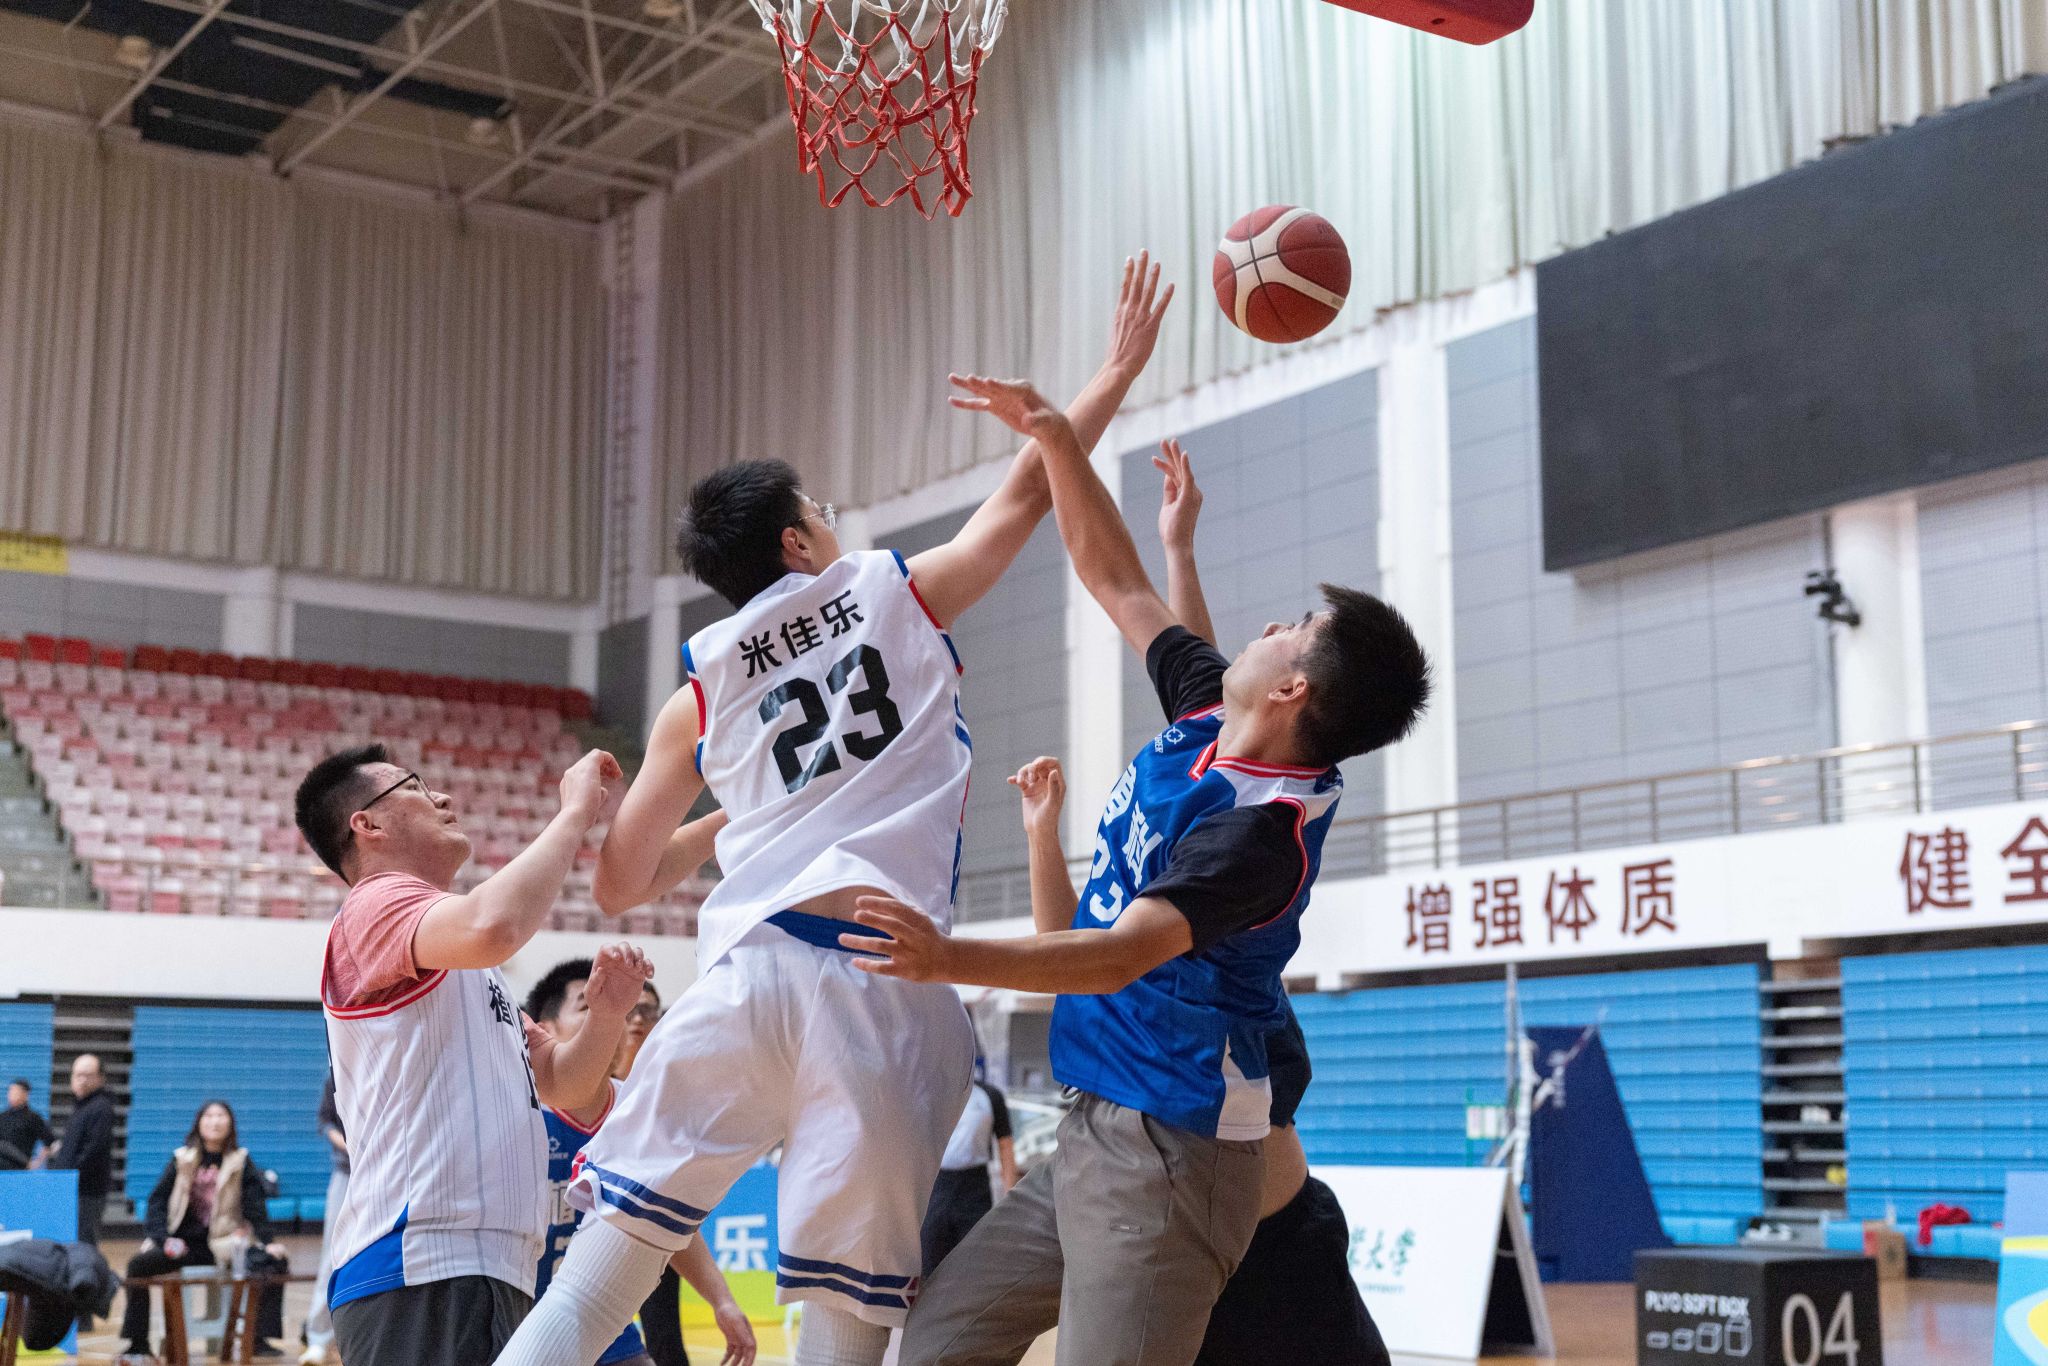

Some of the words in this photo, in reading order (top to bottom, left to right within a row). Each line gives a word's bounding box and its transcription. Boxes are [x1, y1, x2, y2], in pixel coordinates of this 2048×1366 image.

[738, 589, 865, 679] 米佳乐
[758, 643, 904, 794] 23
[1405, 857, 1678, 954] 增强体质
[1899, 815, 2048, 915] 健全
[715, 1213, 769, 1272] 乐
[1645, 1290, 1681, 1314] PLYO
[1682, 1292, 1716, 1316] SOFT
[1717, 1295, 1749, 1318] BOX
[1781, 1291, 1861, 1366] 04
